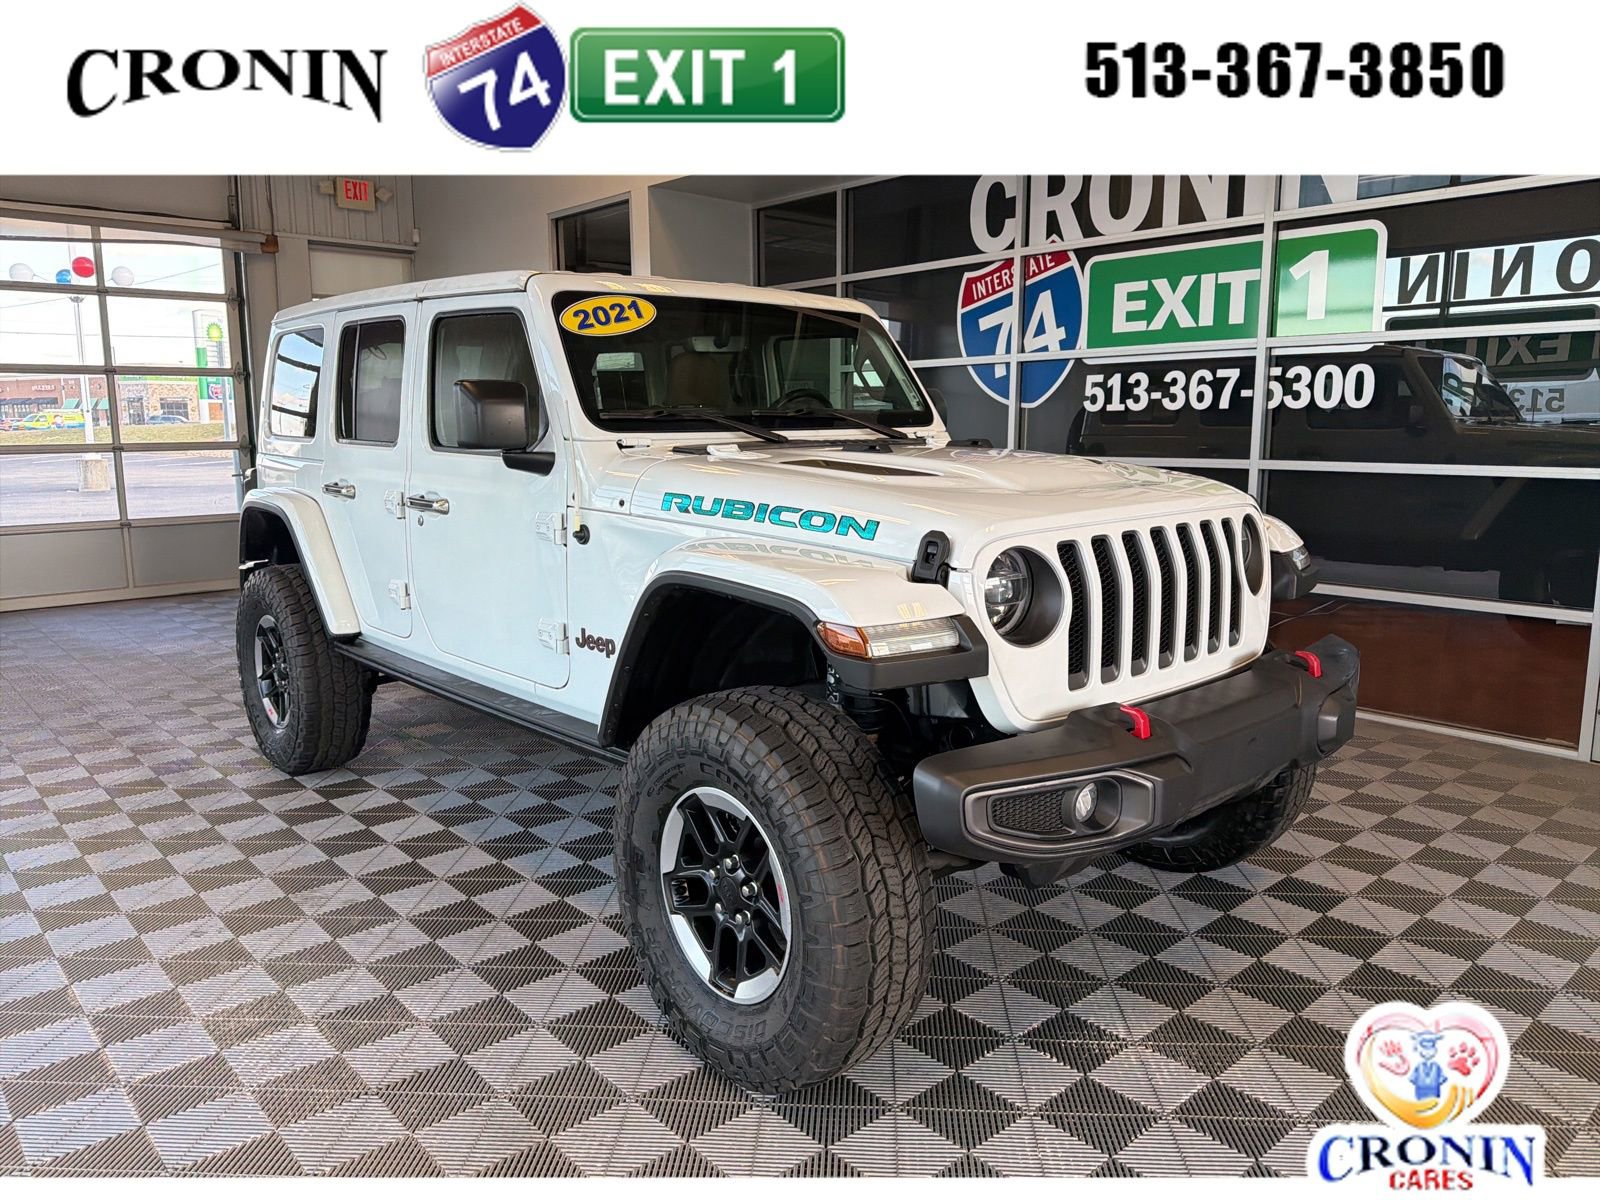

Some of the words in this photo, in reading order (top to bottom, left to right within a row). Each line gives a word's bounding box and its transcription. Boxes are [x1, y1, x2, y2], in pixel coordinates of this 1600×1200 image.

[343, 178, 369, 202] EXIT
[972, 254, 1056, 301] INTERATE
[1112, 268, 1261, 333] EXIT
[1289, 249, 1330, 321] 1
[573, 300, 644, 331] 2021
[978, 289, 1067, 379] 74
[1083, 363, 1375, 412] 513-367-5300
[660, 491, 881, 542] RUBICON
[575, 627, 616, 659] Jeep
